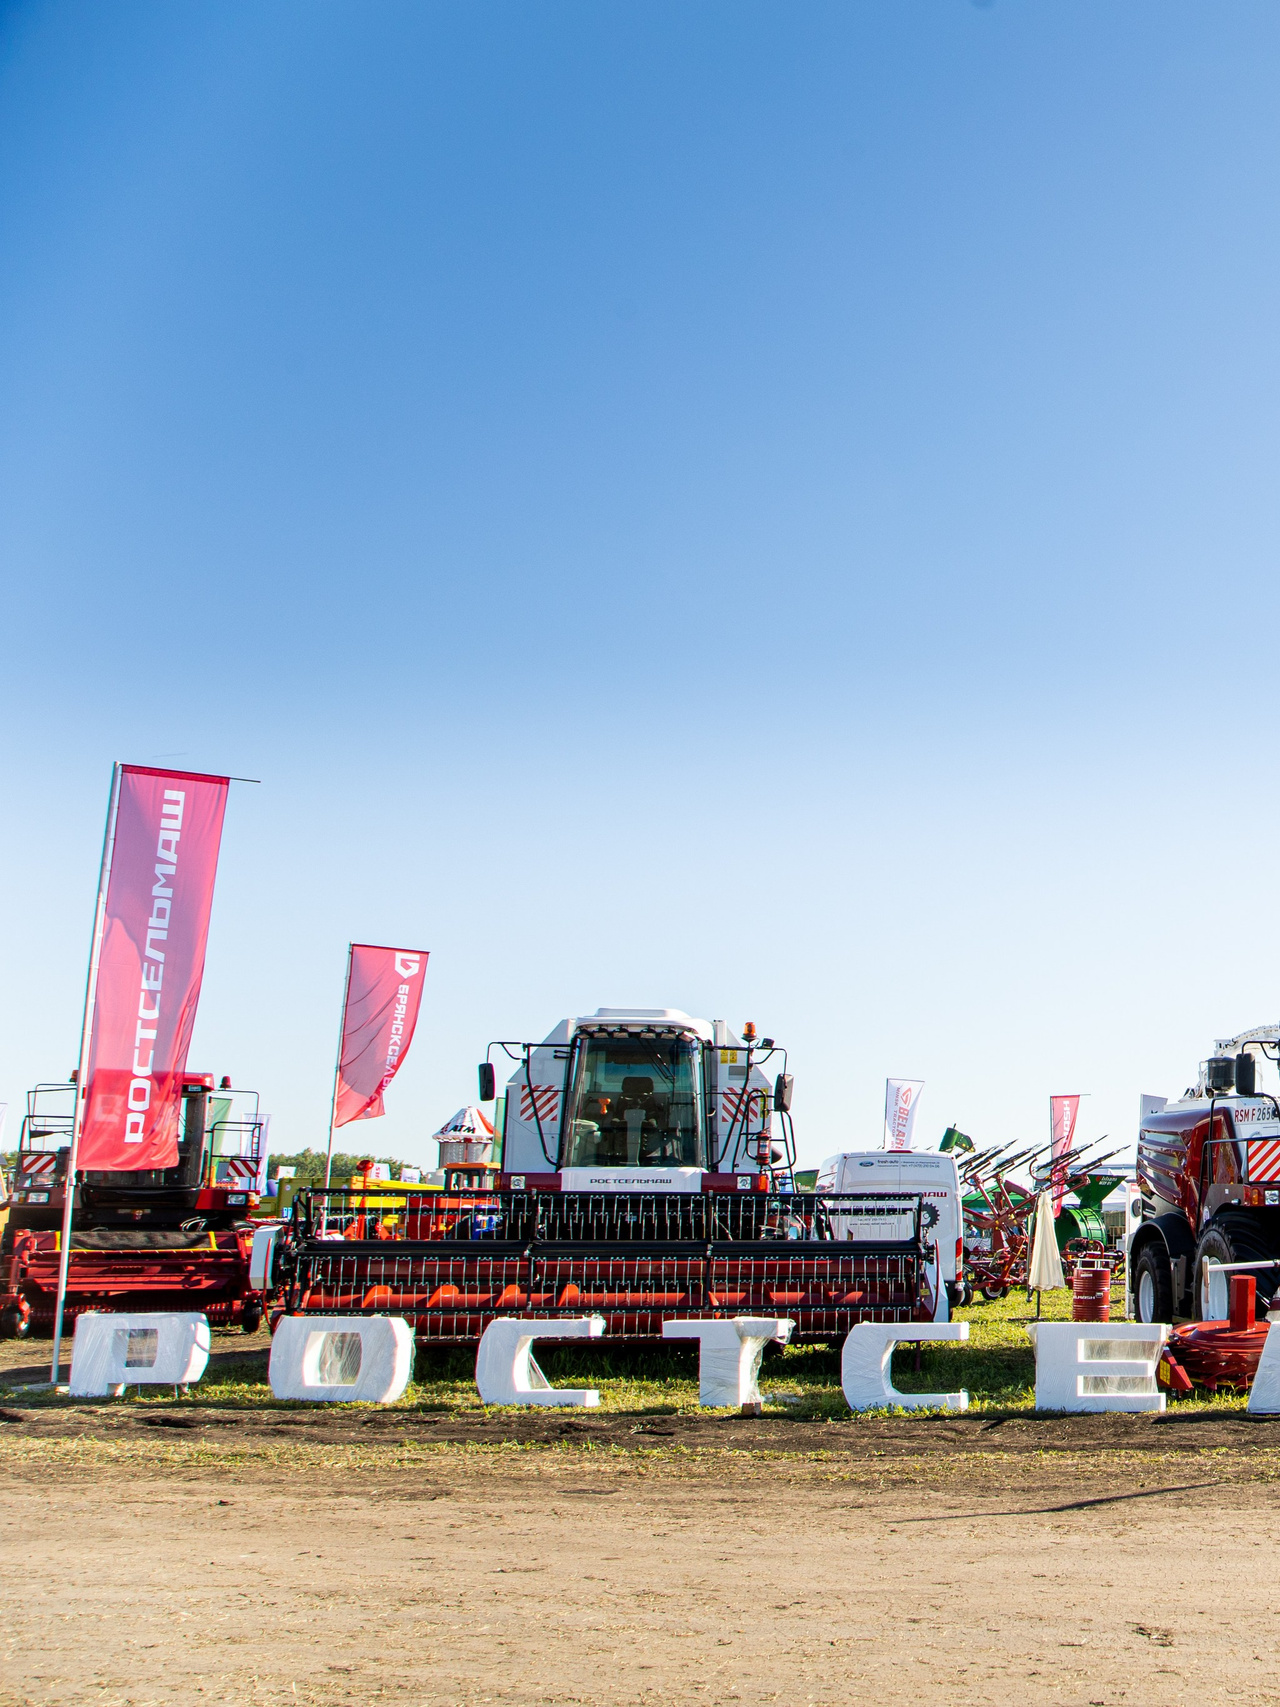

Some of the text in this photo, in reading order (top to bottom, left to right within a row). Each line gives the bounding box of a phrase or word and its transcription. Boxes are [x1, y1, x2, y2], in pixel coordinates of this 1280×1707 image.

[124, 789, 185, 1143] РОСТСЕЛЬМАШ
[895, 1106, 909, 1149] BELAR
[1235, 1109, 1250, 1122] RSM
[1252, 1108, 1256, 1121] F
